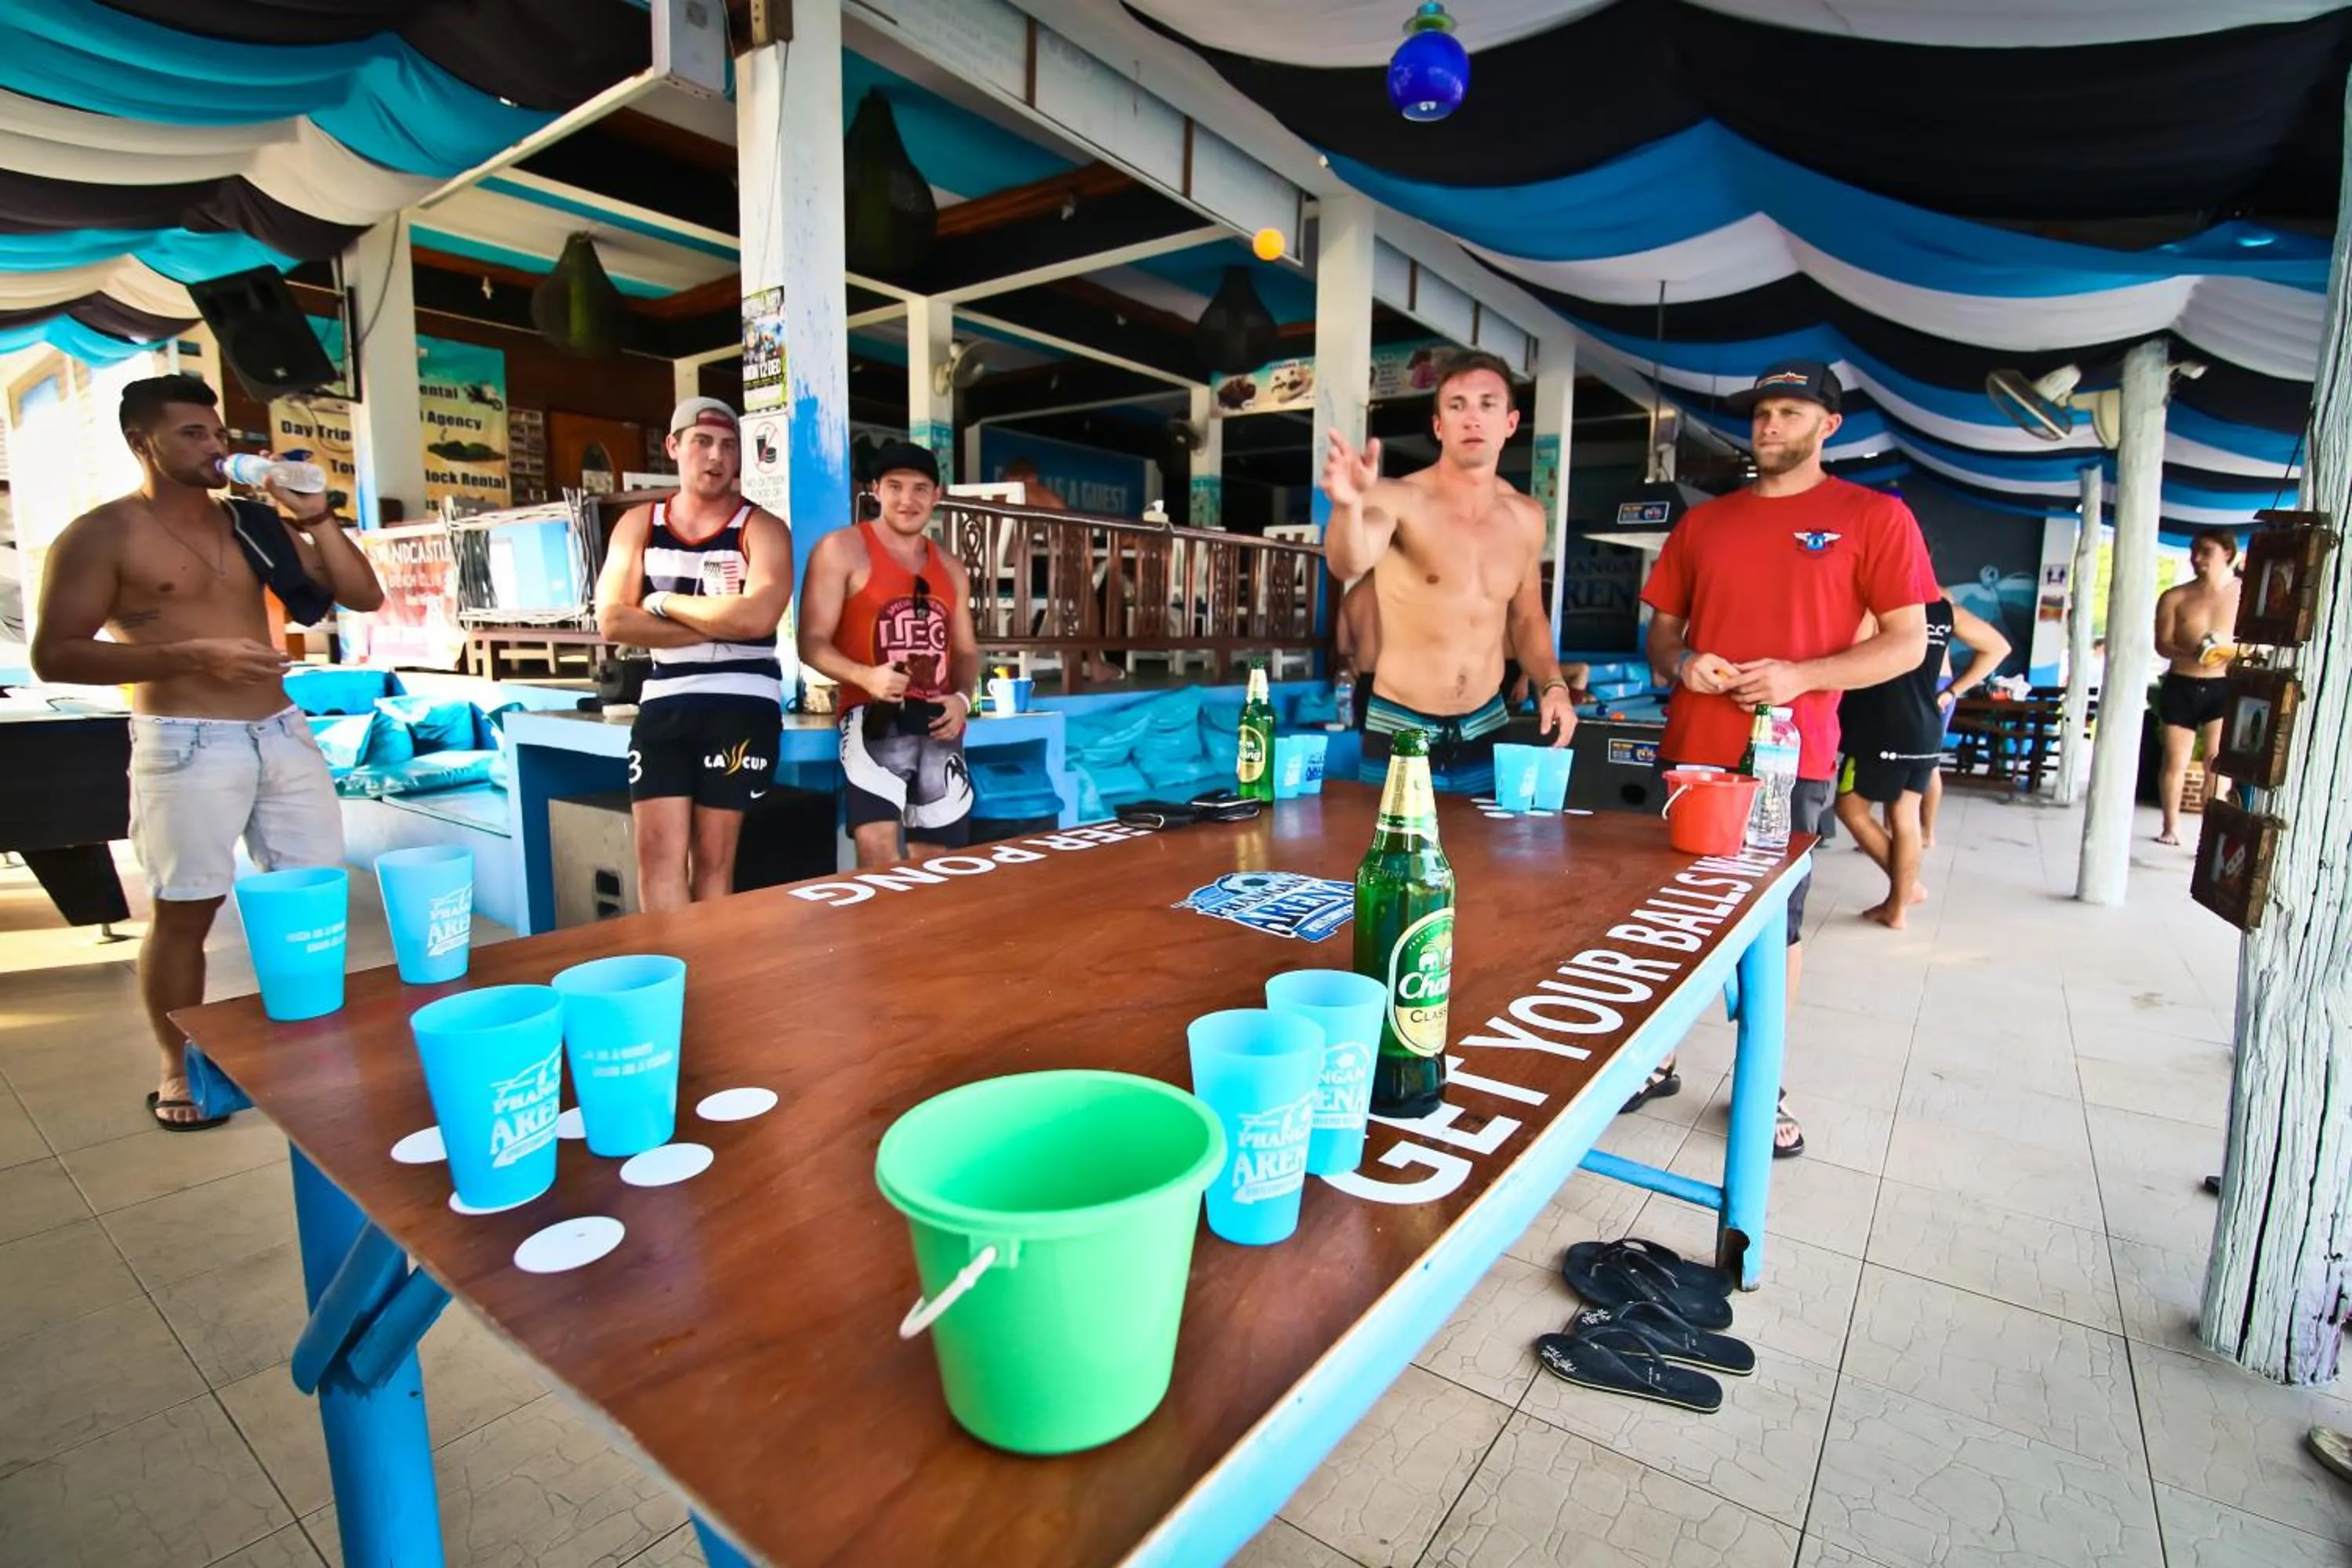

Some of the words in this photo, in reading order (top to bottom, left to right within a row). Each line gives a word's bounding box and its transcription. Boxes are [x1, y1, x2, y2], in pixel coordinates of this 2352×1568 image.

[760, 362, 767, 377] 12
[768, 358, 781, 376] DEC
[418, 384, 459, 399] ental
[281, 419, 313, 436] Day
[427, 409, 481, 430] Agency
[461, 473, 506, 490] Rental
[704, 754, 726, 768] LA
[742, 755, 768, 771] CUP
[787, 845, 1048, 906] PONG
[1234, 880, 1355, 935] ARENA
[426, 913, 471, 948] ARE
[1399, 971, 1450, 1000] Cha
[1322, 1056, 1550, 1205] GET
[1458, 949, 1682, 1061] YOUR
[1607, 872, 1753, 953] BALLS
[1319, 1069, 1366, 1085] NGAN
[1314, 1084, 1367, 1112] ENA
